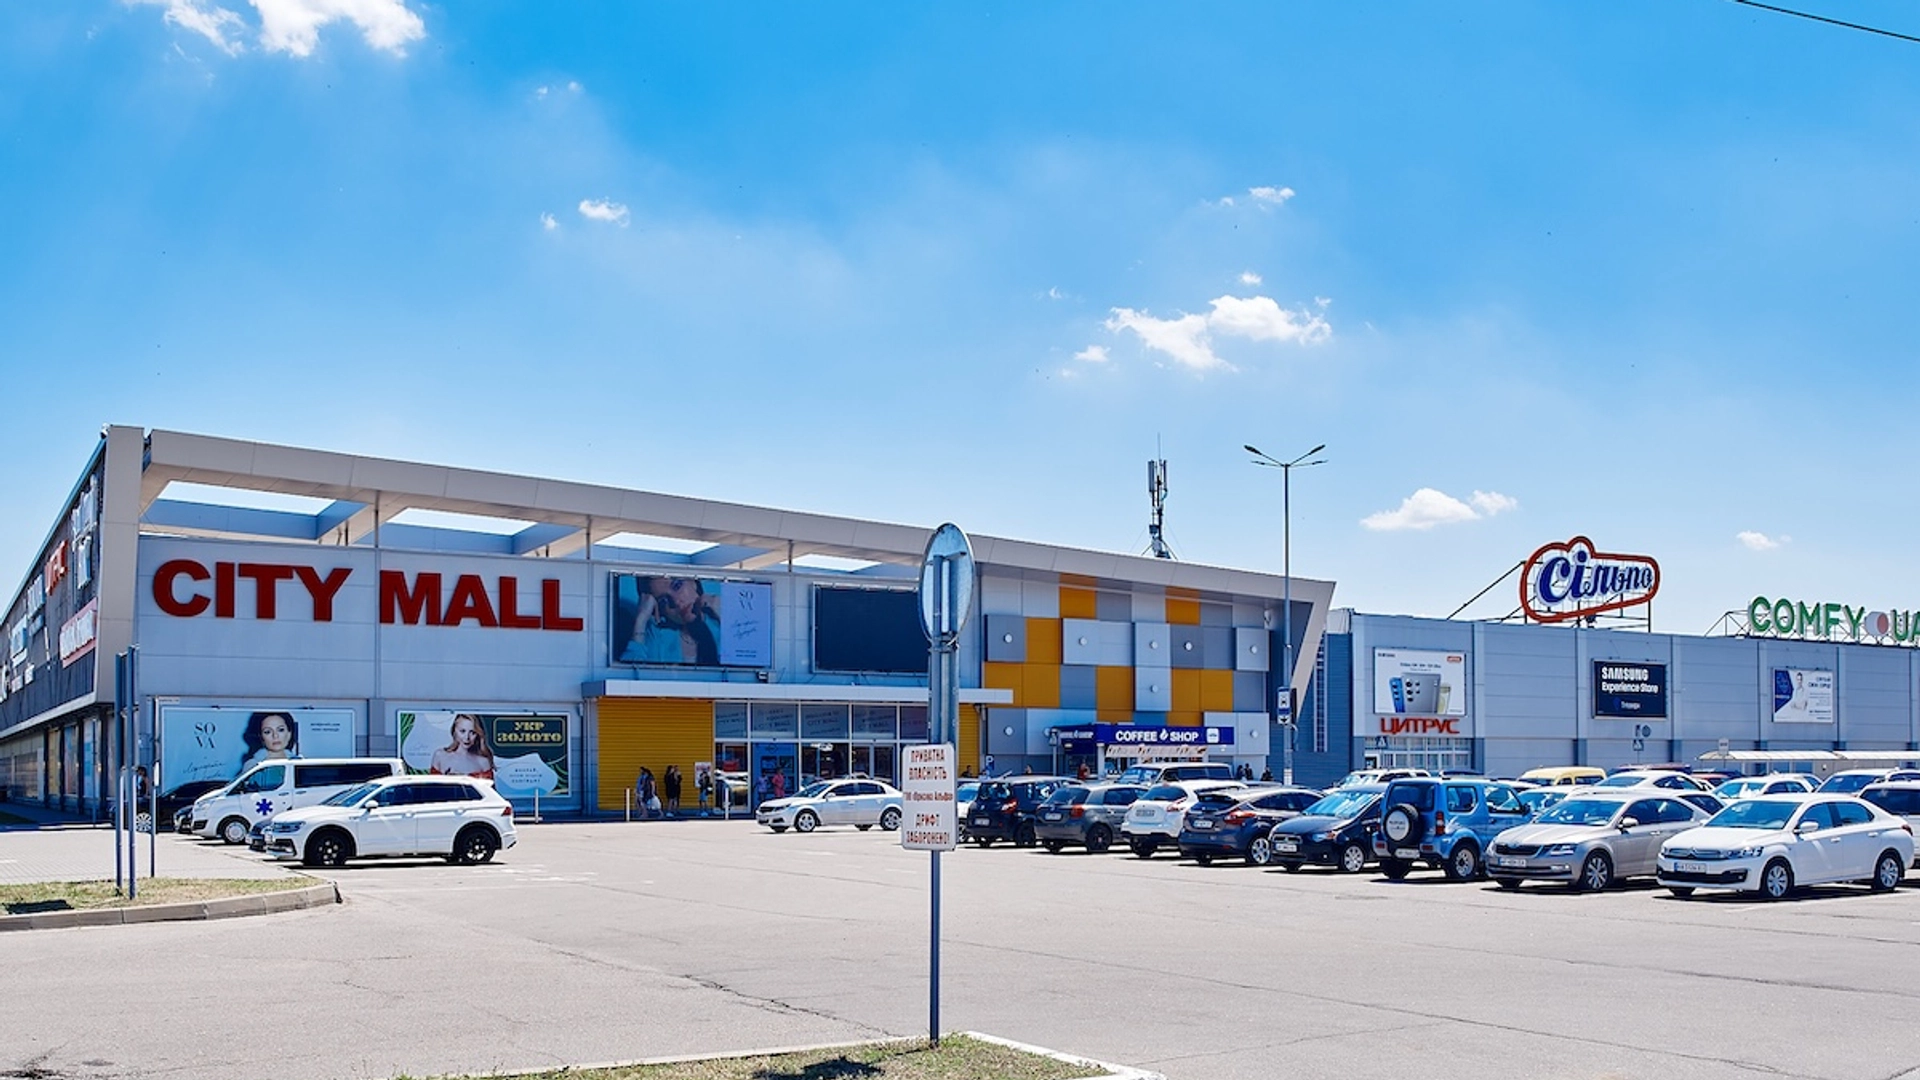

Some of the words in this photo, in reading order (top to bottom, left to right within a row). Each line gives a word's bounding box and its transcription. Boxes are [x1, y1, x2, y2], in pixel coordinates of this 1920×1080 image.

[1536, 550, 1653, 604] Сільпо
[153, 559, 353, 623] CITY
[379, 569, 584, 631] MALL
[1748, 596, 1865, 640] COMFY
[1601, 667, 1649, 681] SAMSUNG
[1601, 682, 1639, 694] Experience
[1640, 683, 1659, 694] Store
[194, 721, 216, 736] SO
[514, 721, 545, 731] УКР
[1380, 717, 1460, 735] ЦИТРУС
[194, 736, 216, 749] VA
[497, 732, 562, 743] ЗОЛОТО
[1115, 730, 1158, 742] COFFEE
[1170, 731, 1199, 742] SHOP
[910, 748, 945, 763] ПРИВАТНА
[908, 766, 947, 781] ВЛАСНІСТЬ
[915, 813, 940, 827] ДРИФТ
[906, 830, 950, 844] ЗАБОРОНЕНО!
